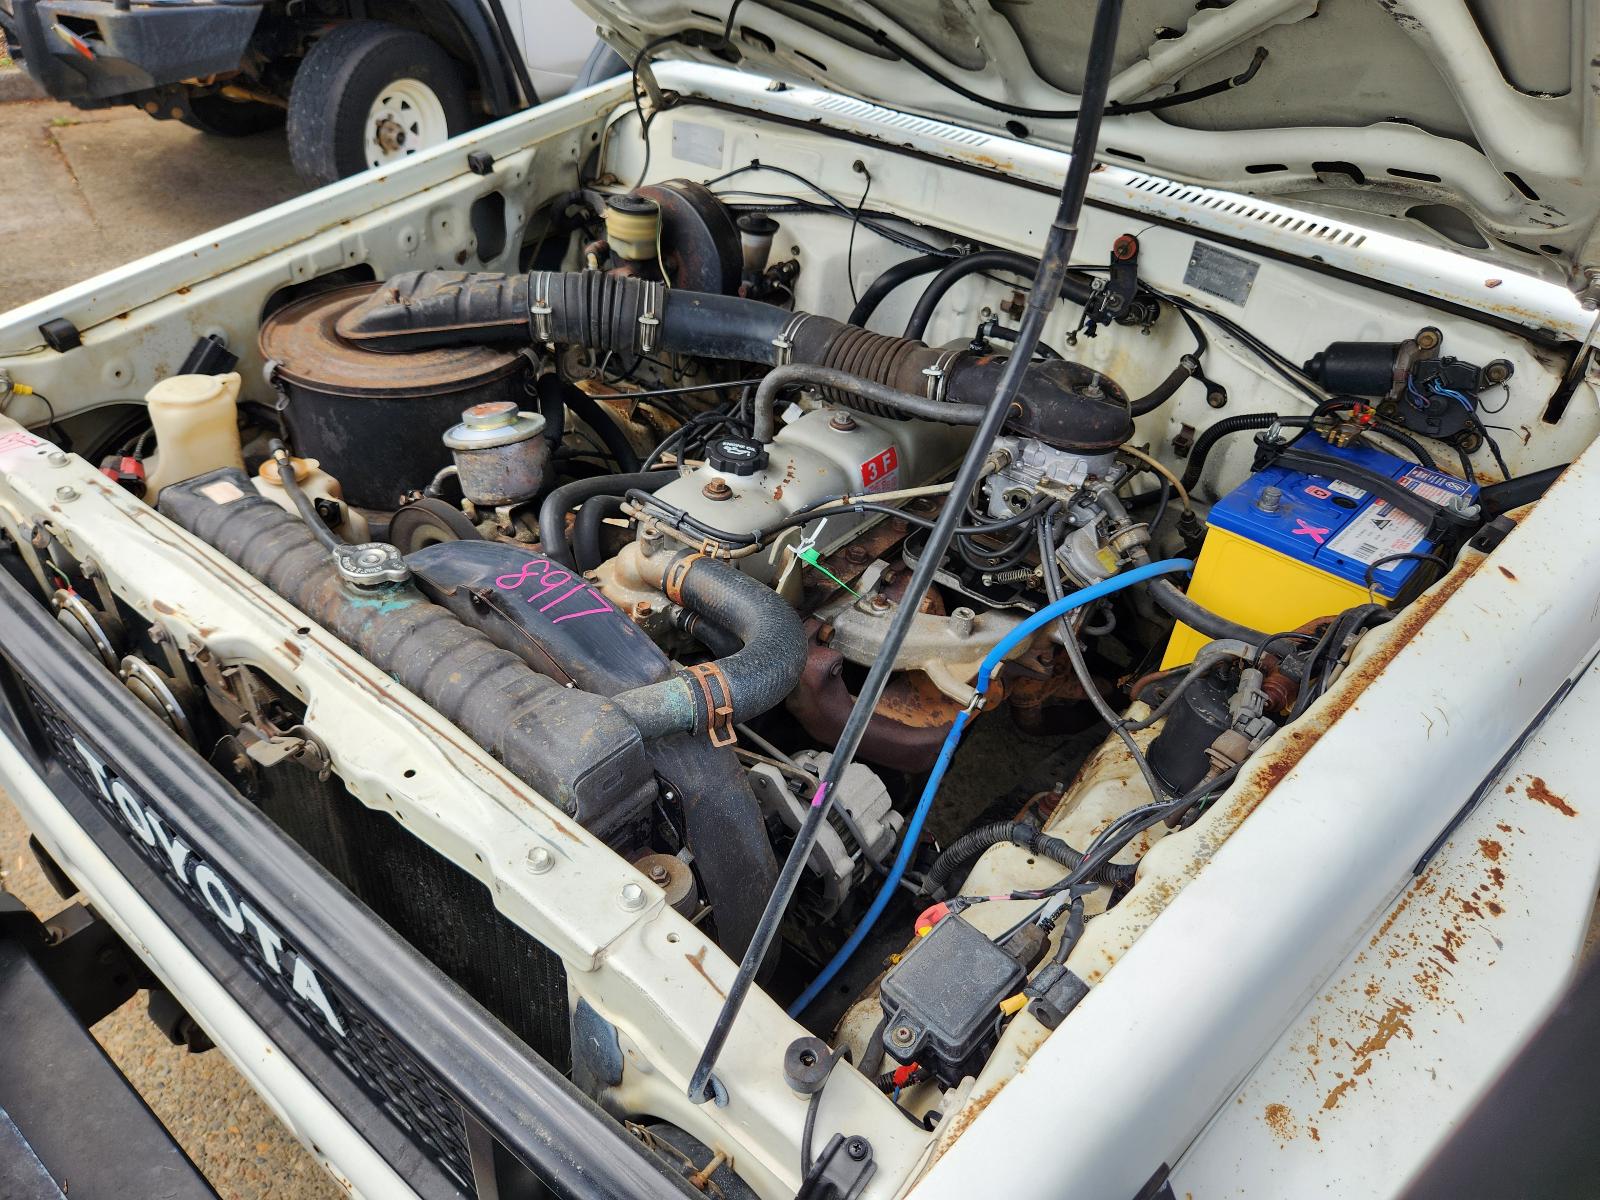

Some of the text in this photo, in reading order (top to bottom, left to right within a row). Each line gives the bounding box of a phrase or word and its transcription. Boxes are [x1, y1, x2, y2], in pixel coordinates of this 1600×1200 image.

[868, 453, 891, 481] 3 F
[495, 559, 614, 624] 8917
[72, 736, 347, 1038] TOYOTA
